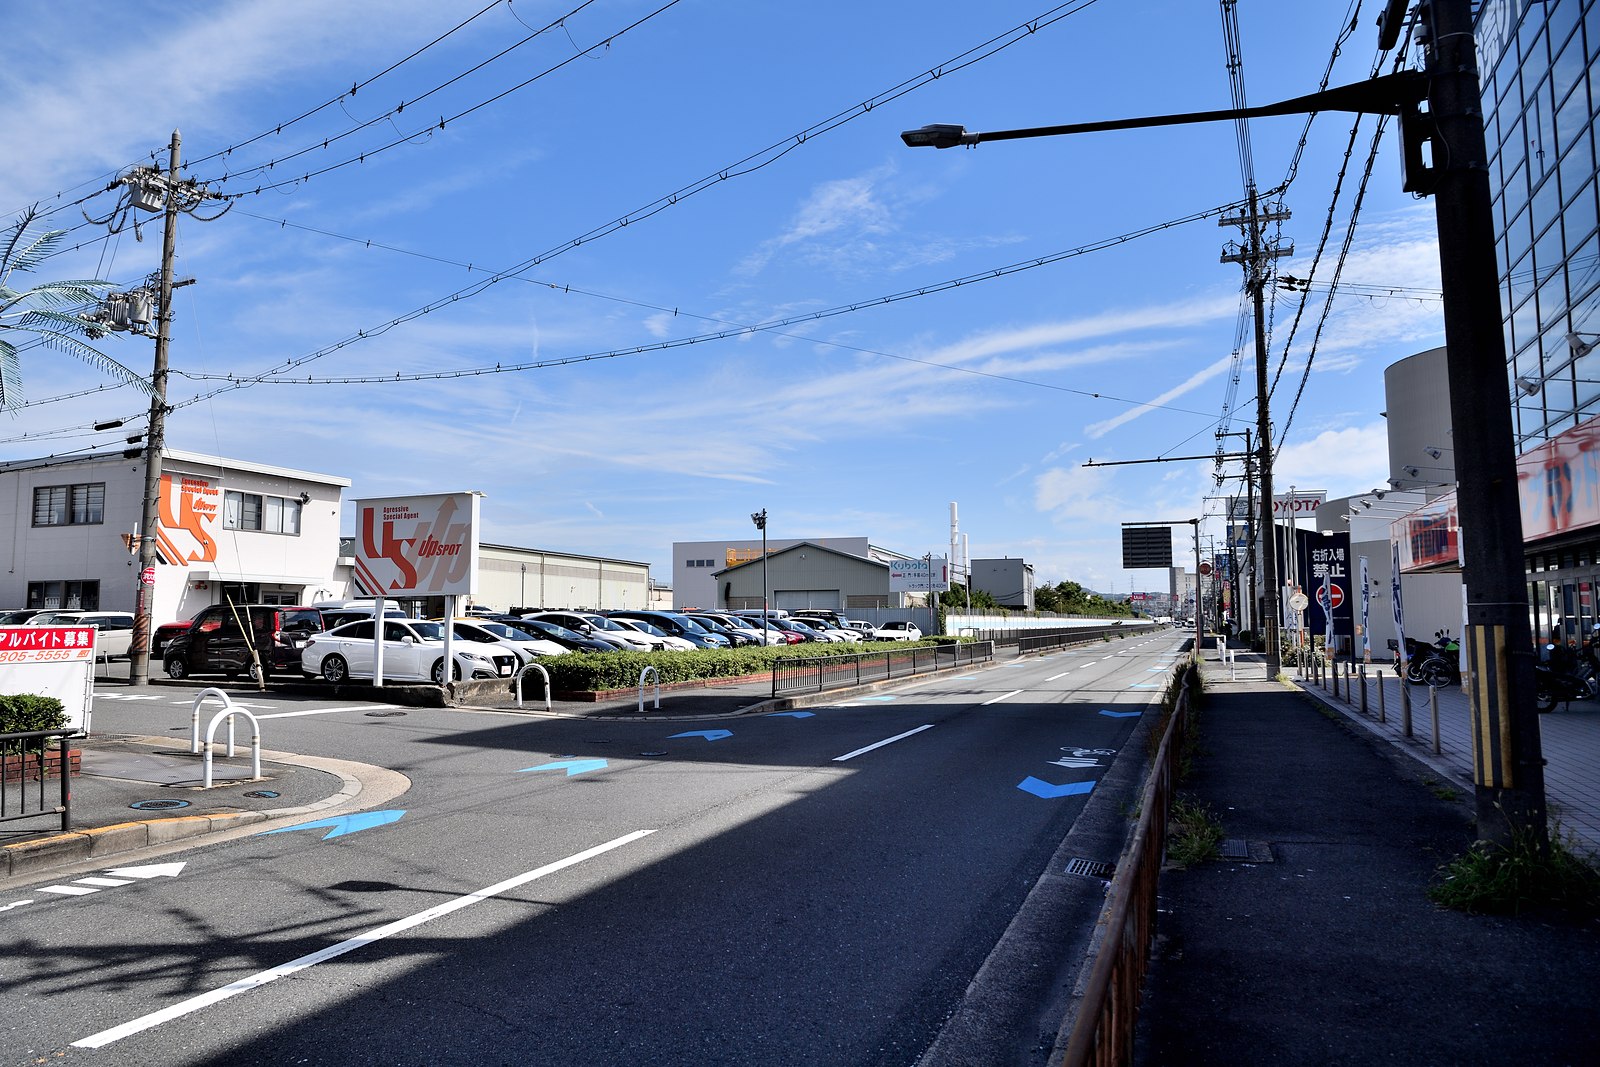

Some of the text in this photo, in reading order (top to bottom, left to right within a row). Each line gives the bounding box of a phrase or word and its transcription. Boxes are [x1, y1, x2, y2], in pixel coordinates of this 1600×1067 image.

[383, 505, 409, 514] Agressive
[1257, 499, 1320, 512] YOTA
[383, 512, 419, 521] Special Agent
[1312, 548, 1345, 562] 右折入場
[890, 560, 928, 570] Kubota
[1313, 563, 1346, 578] 禁止
